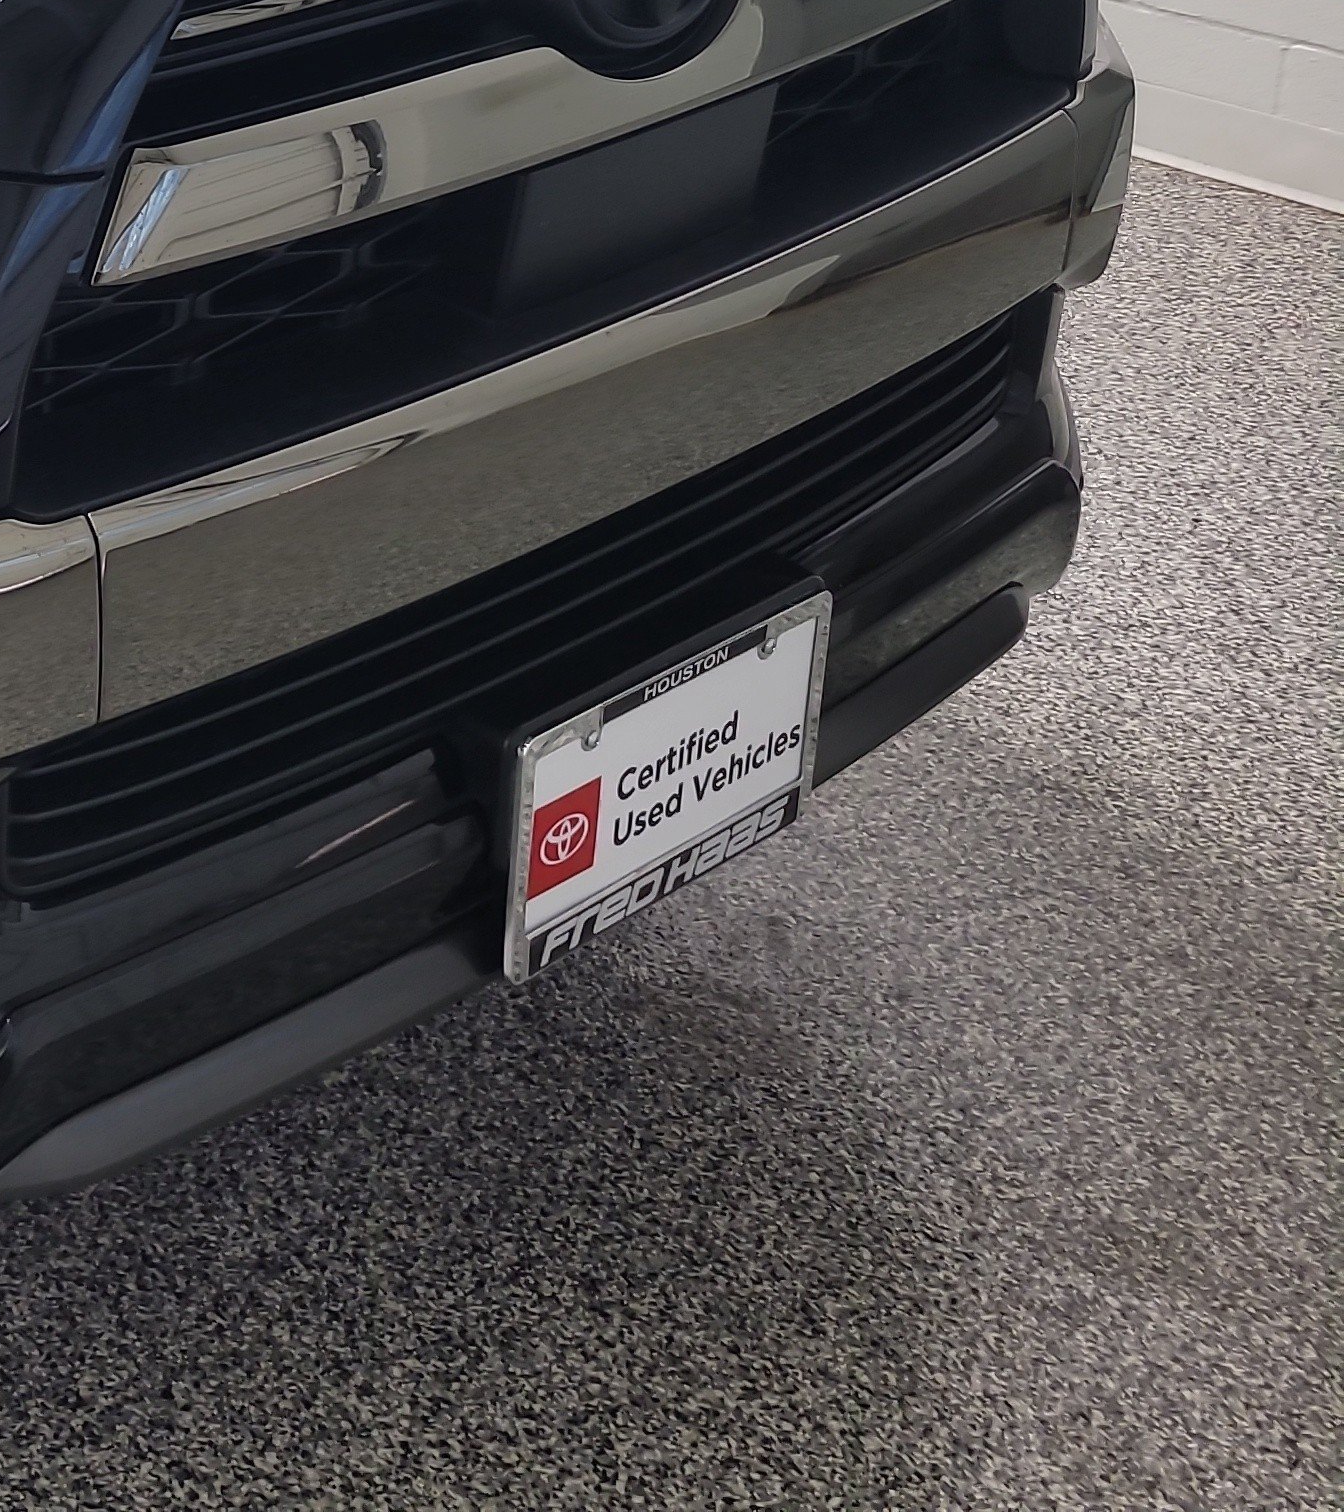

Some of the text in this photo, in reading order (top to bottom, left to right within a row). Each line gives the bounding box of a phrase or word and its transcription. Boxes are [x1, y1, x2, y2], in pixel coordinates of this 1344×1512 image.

[643, 646, 730, 702] HOUSTON
[613, 723, 801, 847] Used Vehicles
[617, 709, 739, 801] Certified
